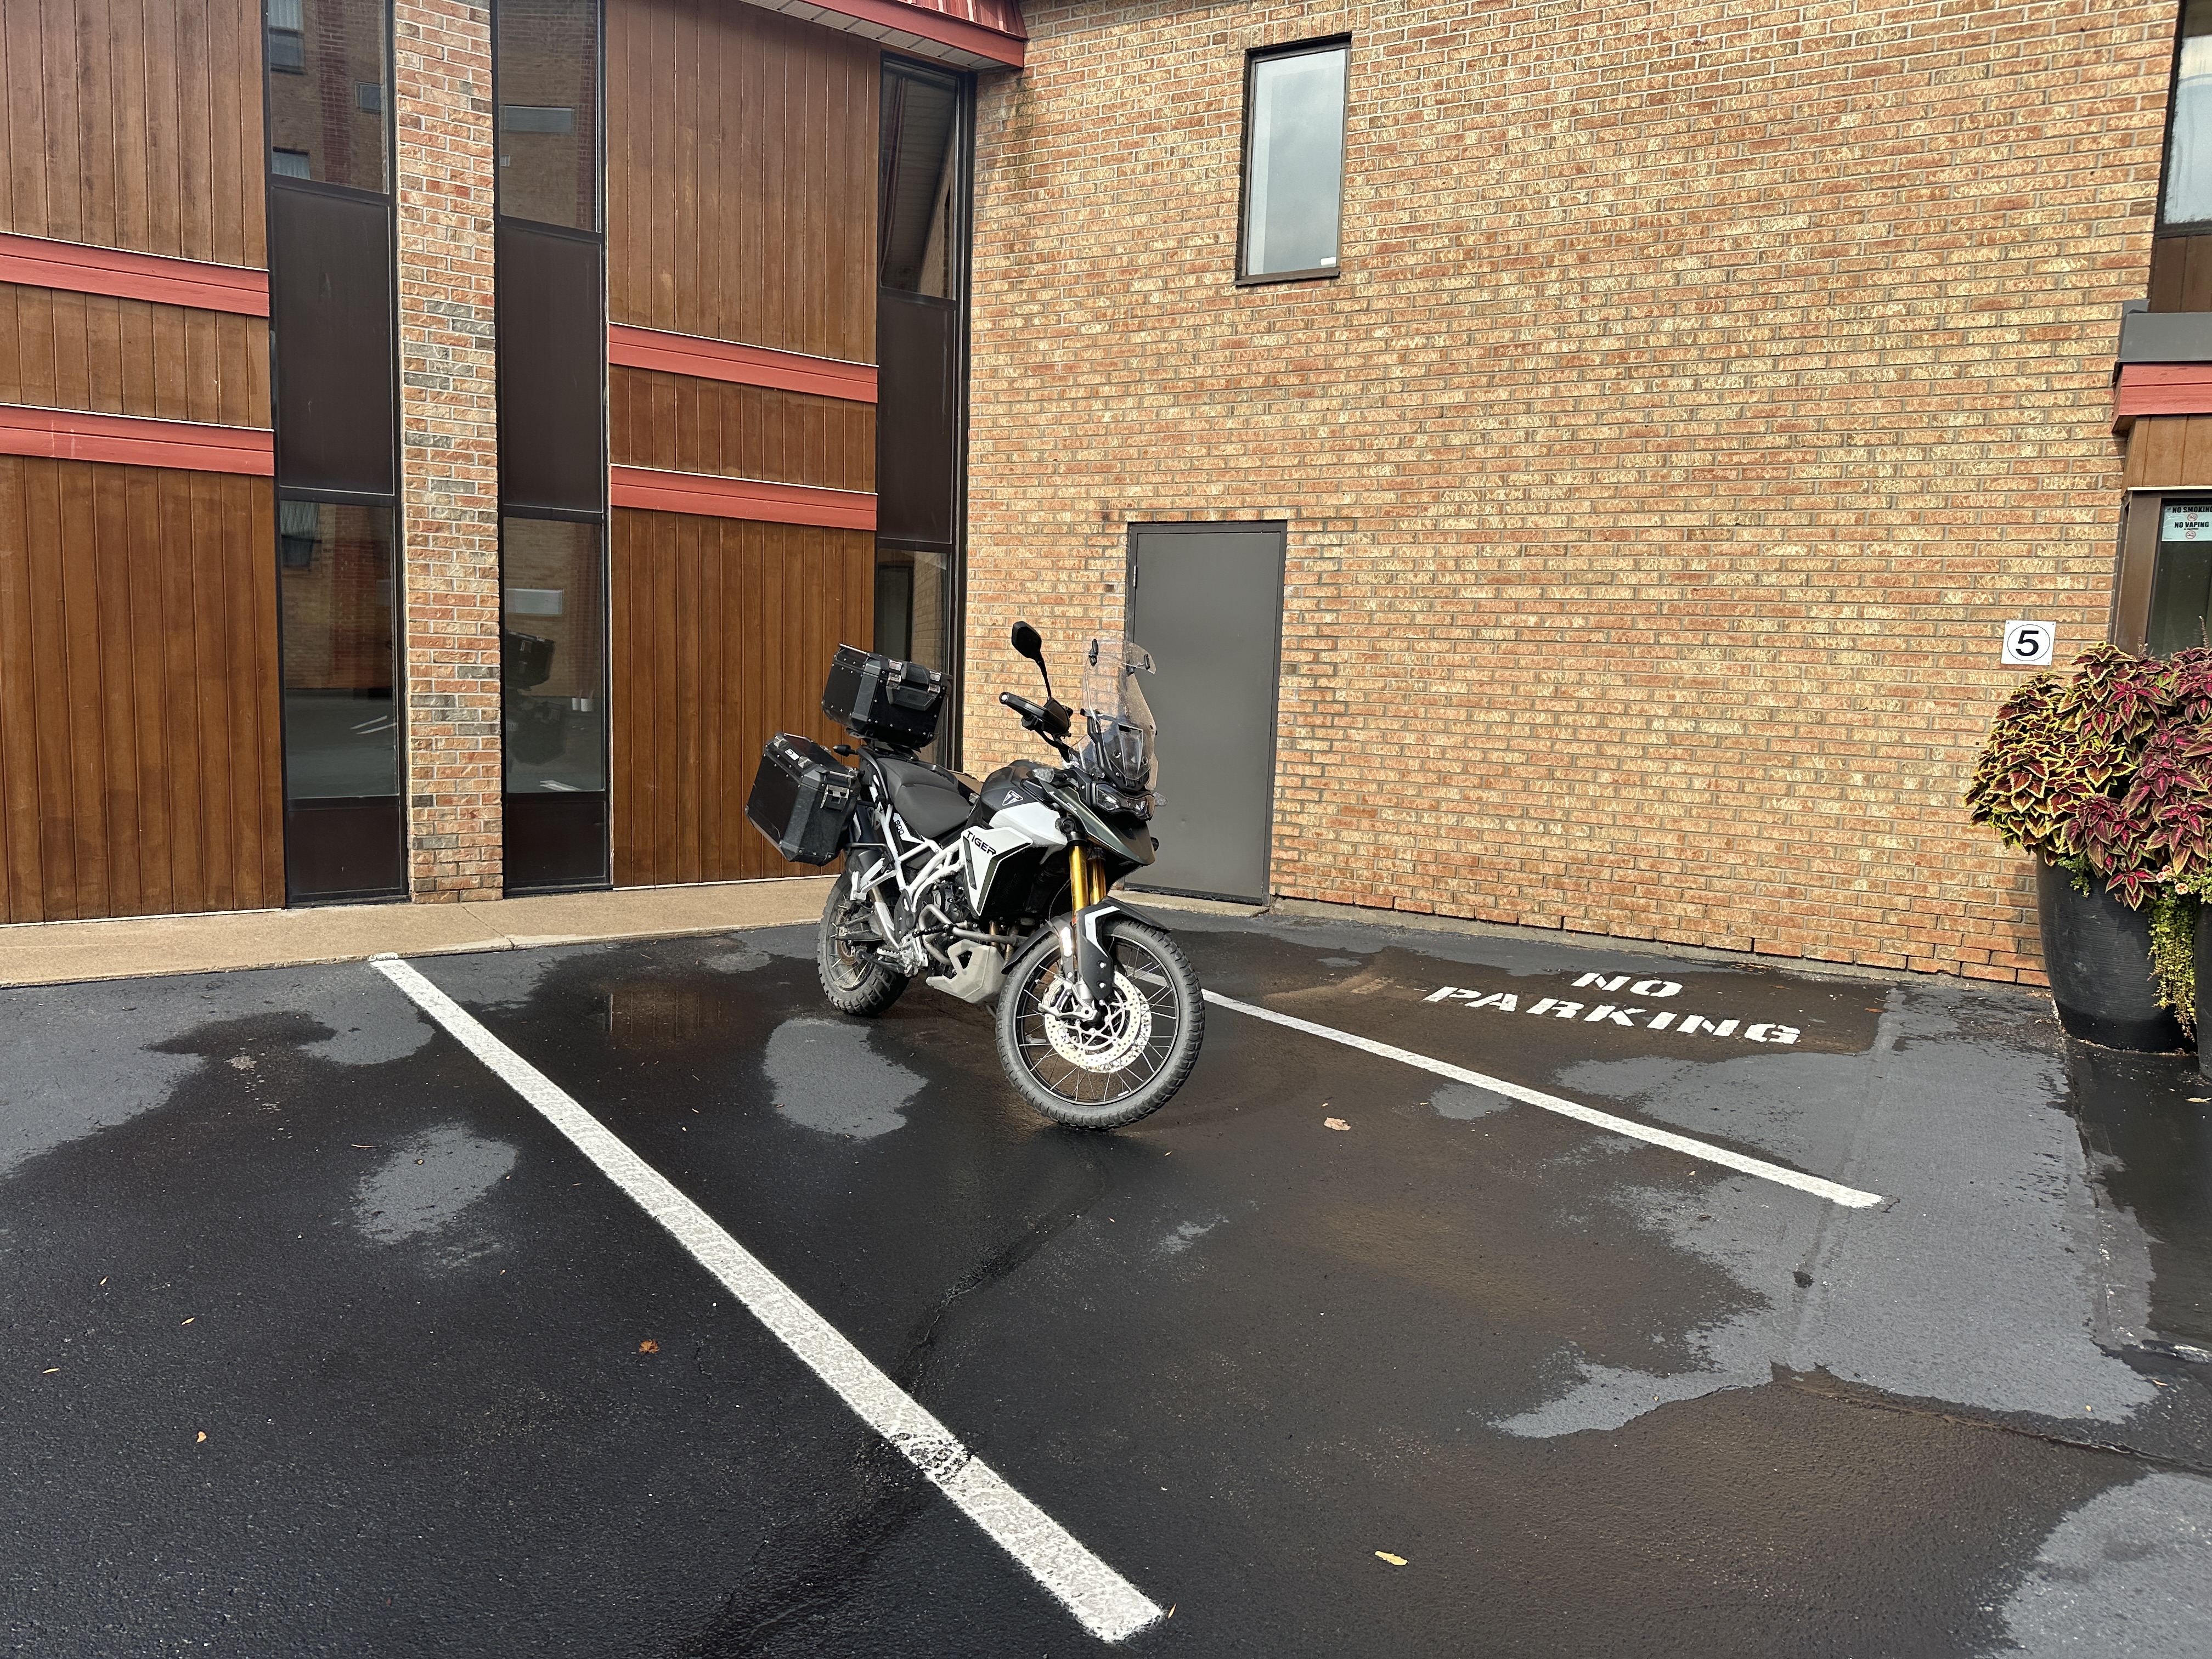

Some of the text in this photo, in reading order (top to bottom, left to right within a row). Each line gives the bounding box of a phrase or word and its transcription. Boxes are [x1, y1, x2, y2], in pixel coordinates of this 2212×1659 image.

[2016, 630, 2039, 656] 5
[967, 831, 996, 855] TIGER
[1571, 973, 1683, 997] NO
[1423, 986, 1801, 1045] PARKING
